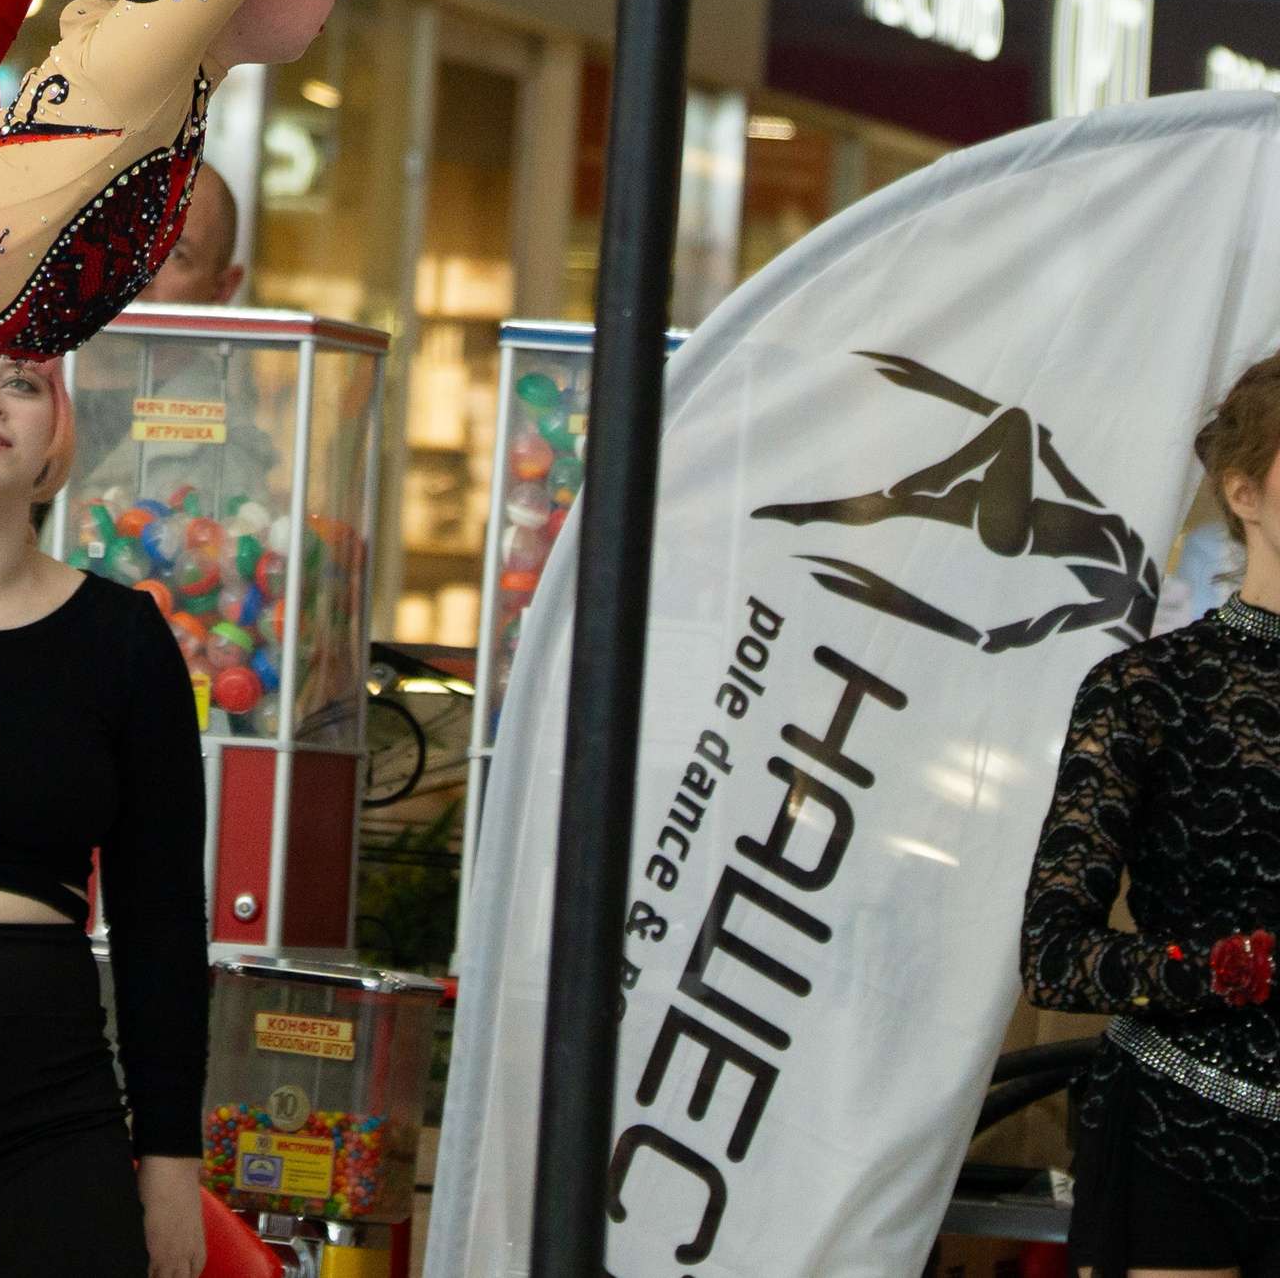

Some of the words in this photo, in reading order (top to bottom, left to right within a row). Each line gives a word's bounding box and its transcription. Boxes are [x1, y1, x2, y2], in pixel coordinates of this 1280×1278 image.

[146, 425, 214, 439] ИГРУШКА
[715, 595, 785, 720] pole
[645, 729, 734, 892] dance
[625, 900, 668, 942] &
[606, 645, 908, 1278] НАШЕС
[267, 1017, 340, 1036] КОНФЕТЫ
[260, 1035, 320, 1053] НЕСКОЛЬКО
[323, 1042, 354, 1058] ШТУК
[273, 1091, 297, 1117] 10
